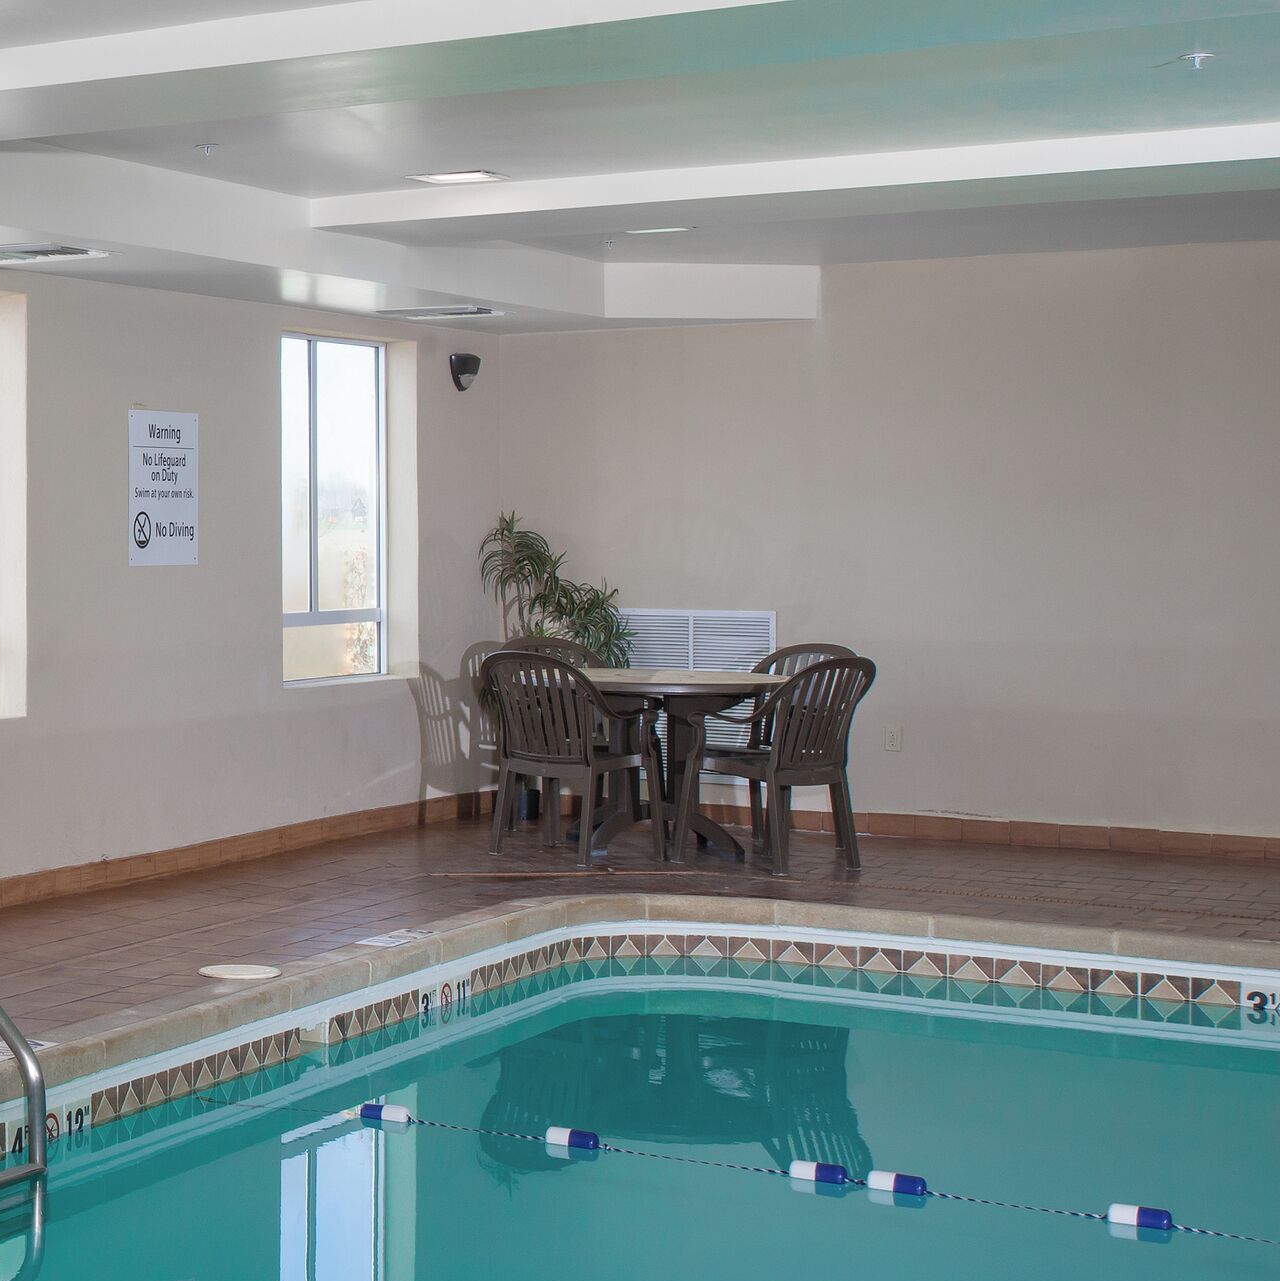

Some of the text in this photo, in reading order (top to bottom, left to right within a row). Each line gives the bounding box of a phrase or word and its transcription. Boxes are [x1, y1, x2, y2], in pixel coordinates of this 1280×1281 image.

[148, 424, 181, 444] Warning
[142, 452, 186, 470] No Lifeguard
[150, 468, 178, 485] on Duty
[134, 486, 194, 501] Swim at your own risk.
[155, 521, 194, 541] No Diving
